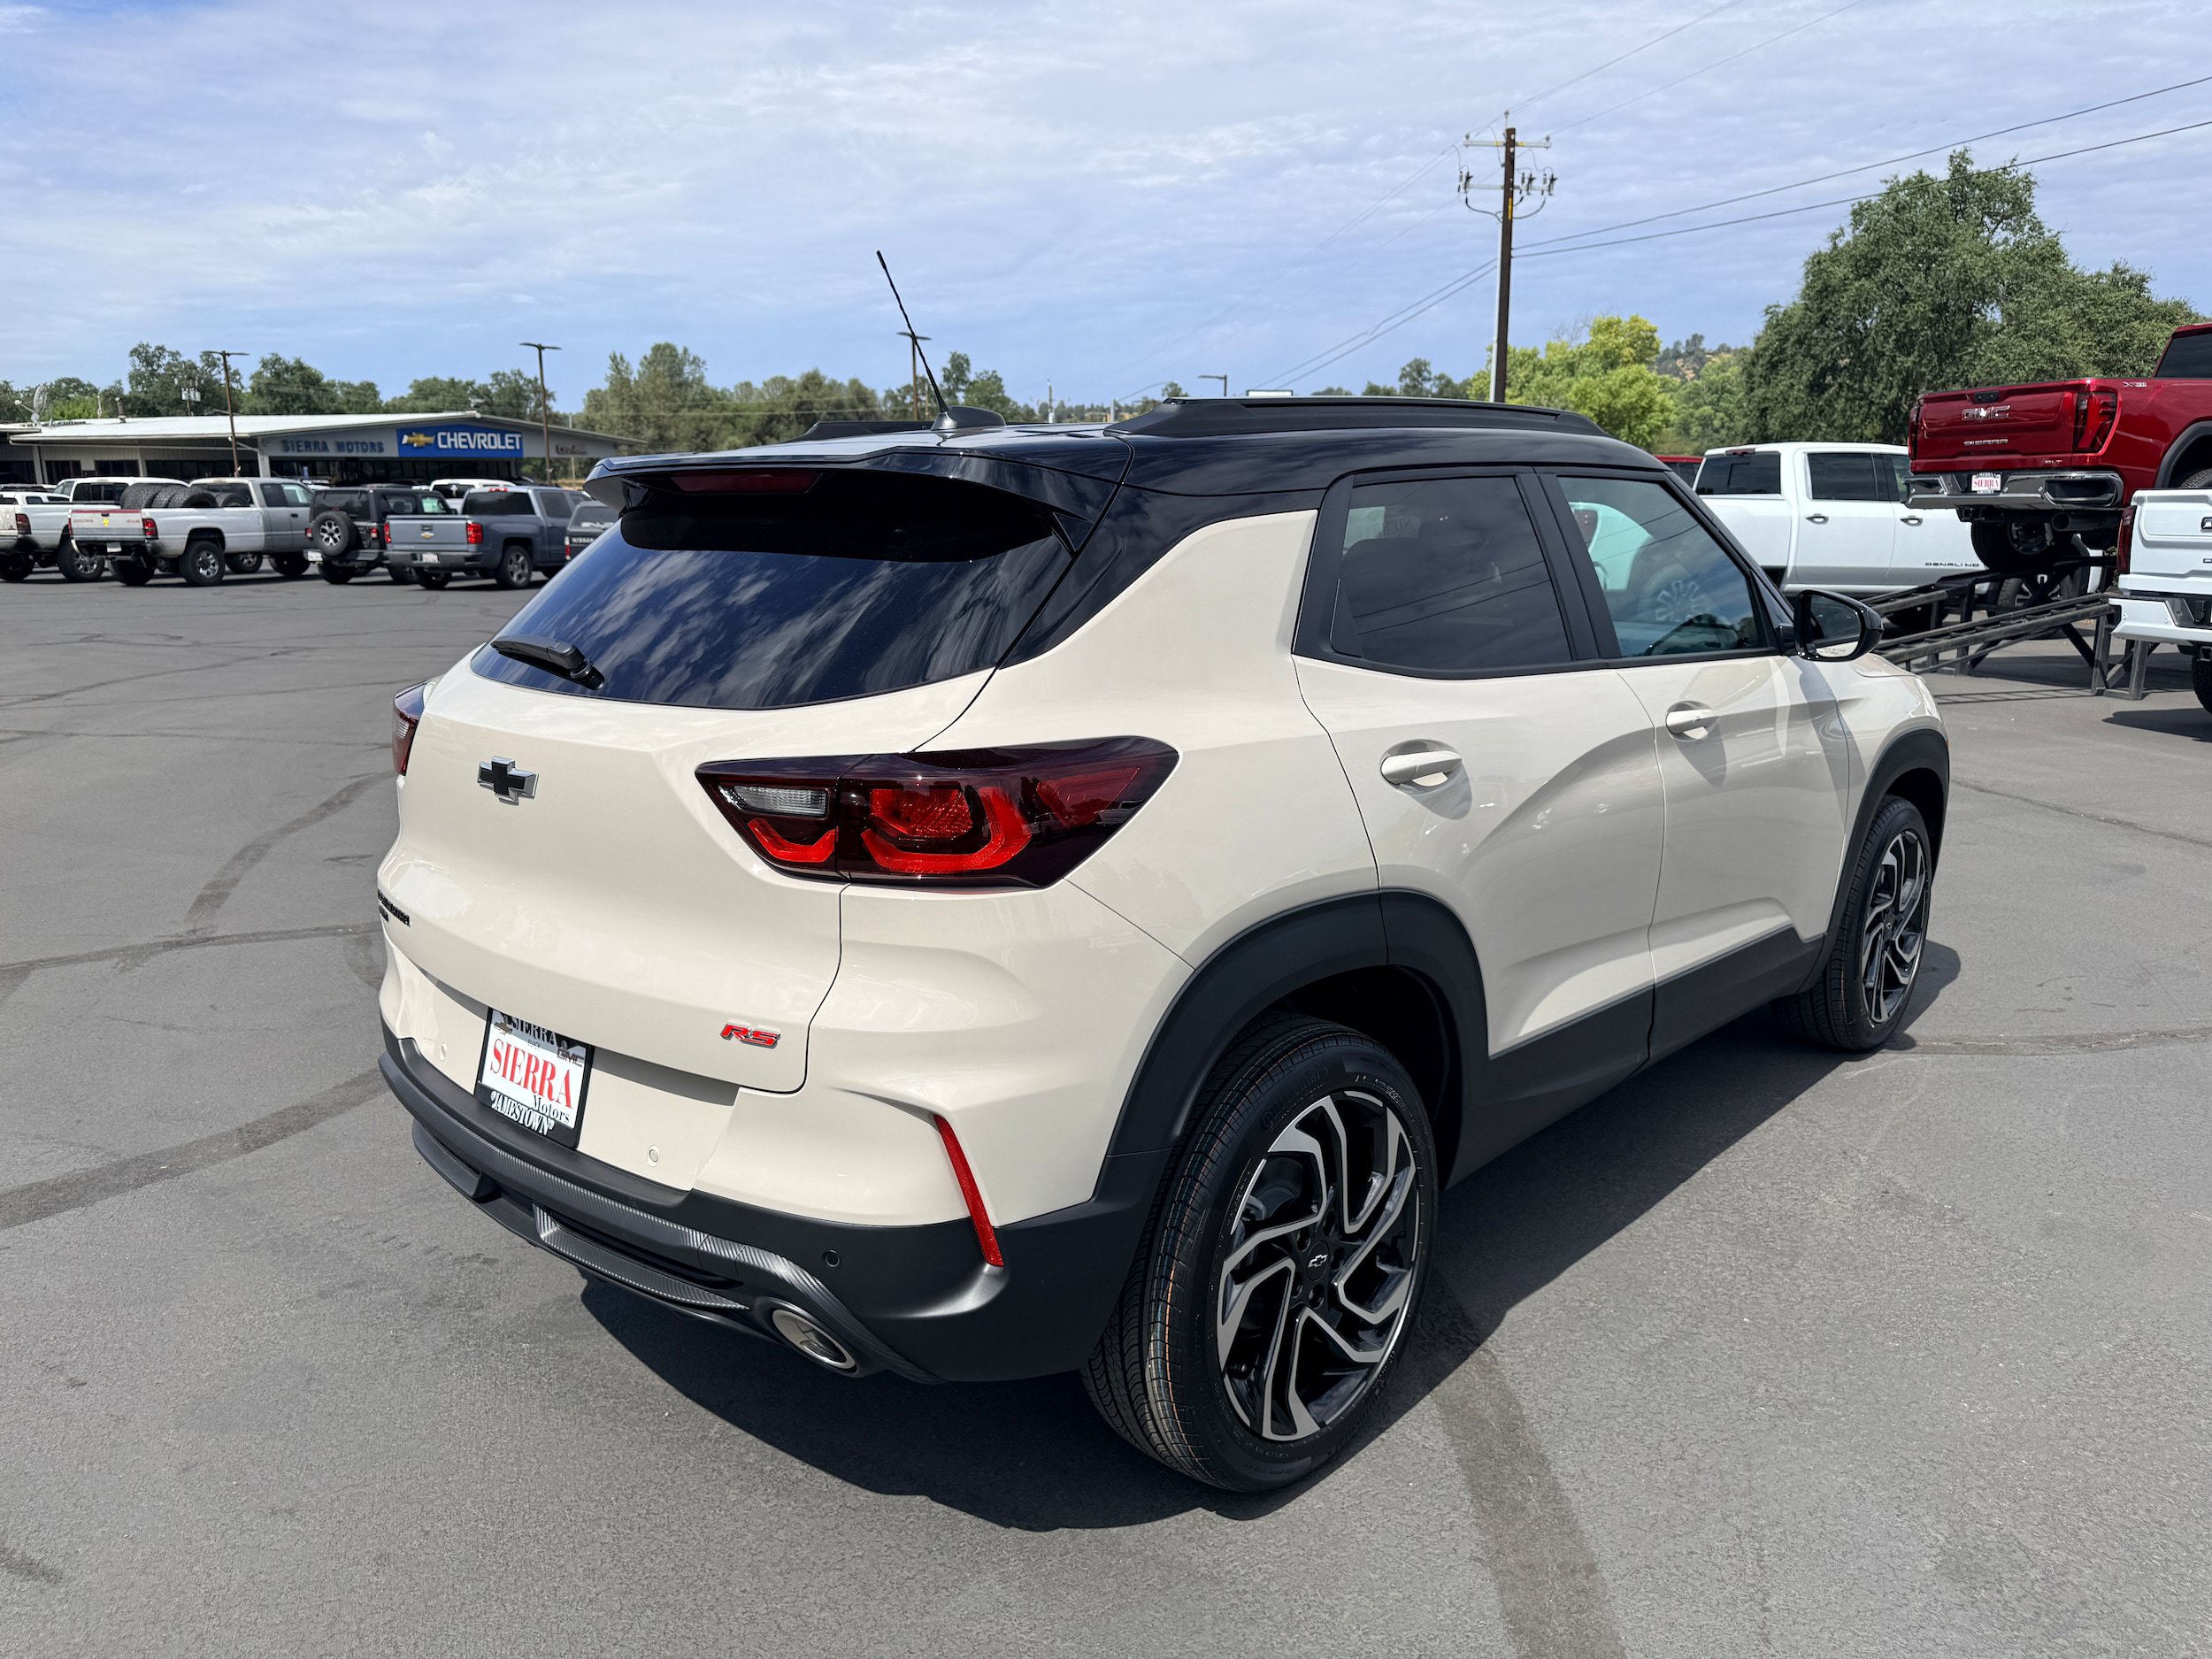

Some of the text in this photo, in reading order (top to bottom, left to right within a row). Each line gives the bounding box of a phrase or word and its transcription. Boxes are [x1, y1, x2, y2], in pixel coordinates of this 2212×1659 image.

[1962, 405, 2010, 421] GMC
[281, 439, 385, 454] SIERRA MOTORS
[437, 431, 522, 450] CHEVROLET
[1974, 480, 1999, 488] SIERRA
[510, 1017, 558, 1046] SIERRA
[720, 1022, 781, 1049] RS
[557, 1048, 585, 1068] GMC
[490, 1038, 573, 1110] SIERRA
[491, 1092, 549, 1136] JAMESTOWN
[531, 1094, 570, 1125] Motors
